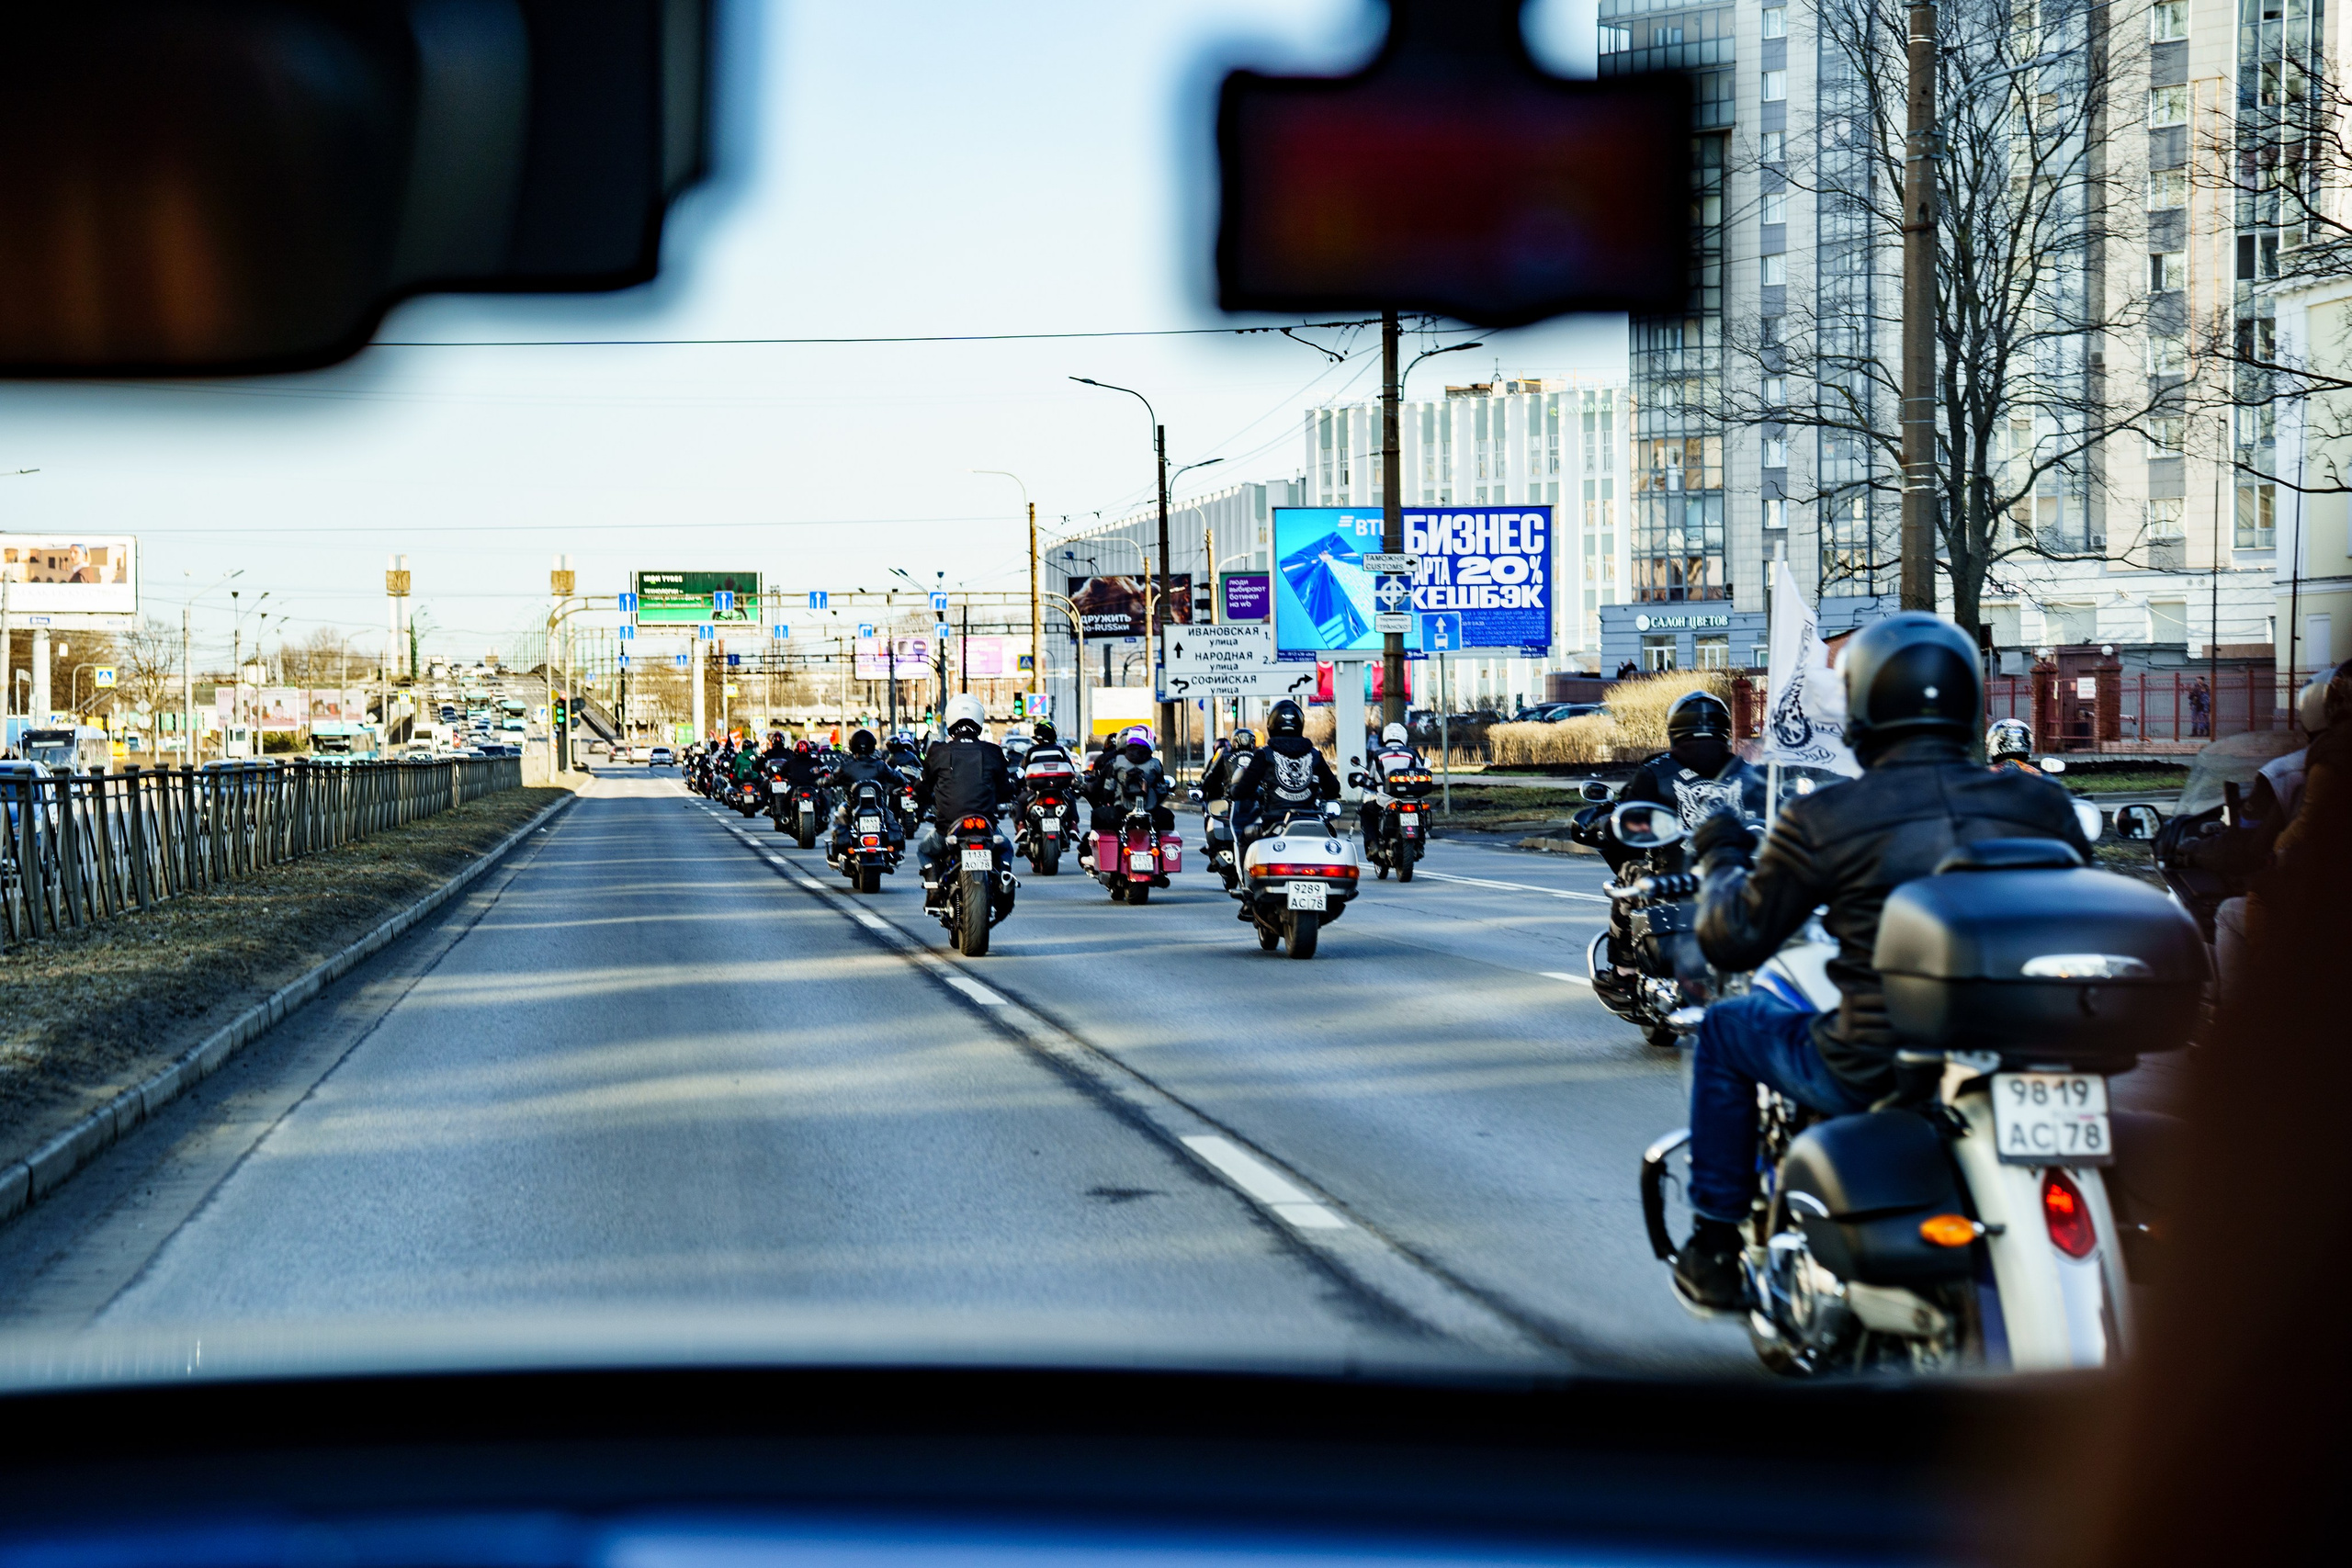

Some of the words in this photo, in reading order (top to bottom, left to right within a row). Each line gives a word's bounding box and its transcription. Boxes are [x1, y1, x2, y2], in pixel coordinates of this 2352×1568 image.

[1404, 513, 1544, 555] БИЗНЕС
[1405, 556, 1451, 585] АРТА
[1228, 585, 1266, 593] выбирают
[1411, 584, 1544, 610] КЕШБЭК
[1080, 614, 1132, 625] ДРУЖИТЬ
[1651, 616, 1686, 628] САЛОН
[1689, 615, 1729, 630] ЦВЕТОВ
[1188, 626, 1260, 637] ИВАНОВСКАЯ
[1209, 637, 1238, 648] улица
[1194, 651, 1253, 661] НАРОДНАЯ
[1209, 661, 1238, 671] улица
[1191, 673, 1257, 685] СОФИЙСКАЯ
[1210, 685, 1239, 695] улица
[968, 851, 988, 859] 1133
[1294, 884, 1320, 895] 9289
[1310, 898, 1324, 909] 78
[2009, 1078, 2088, 1106] 9819
[2064, 1122, 2102, 1149] 78
